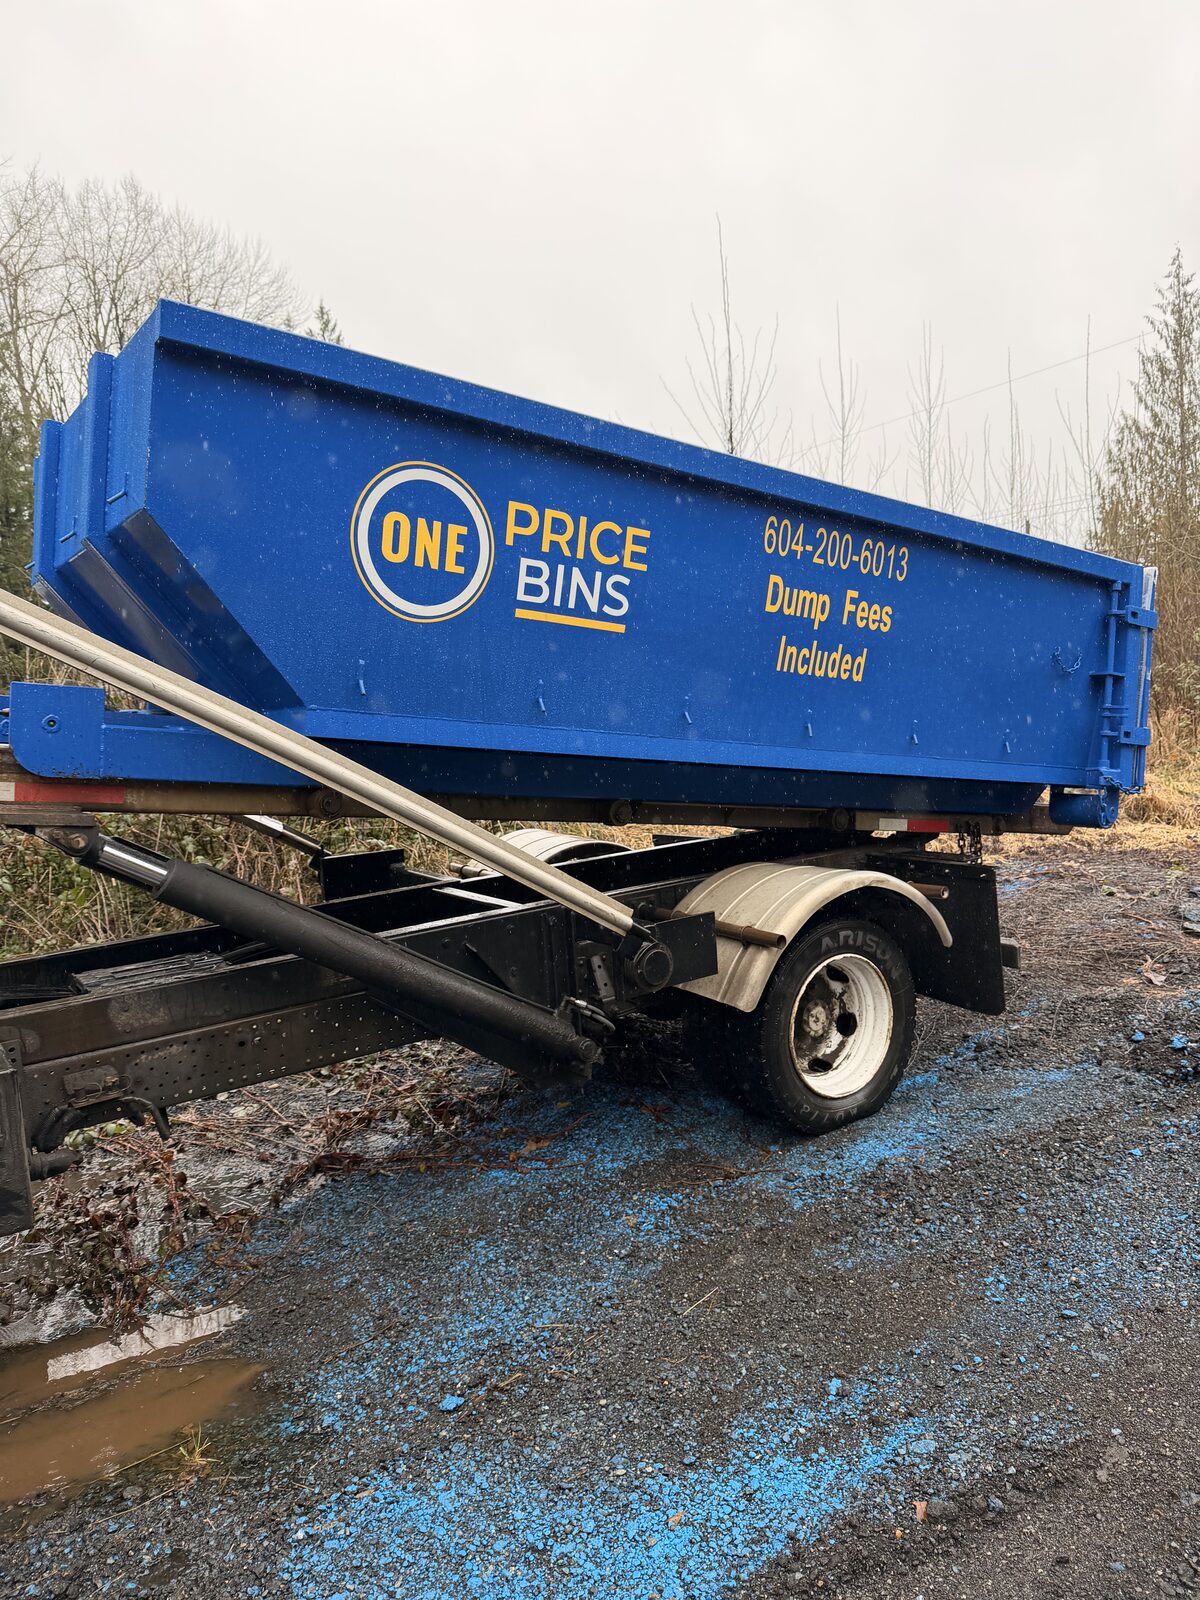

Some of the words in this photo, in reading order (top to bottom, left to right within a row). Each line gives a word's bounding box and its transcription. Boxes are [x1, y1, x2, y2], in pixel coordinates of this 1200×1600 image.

[381, 511, 468, 574] ONE
[505, 500, 651, 572] PRICE
[763, 515, 909, 582] 604-200-6013
[516, 557, 631, 617] BINS
[764, 574, 831, 630] Dump
[842, 589, 893, 633] Fees
[776, 635, 868, 682] Included
